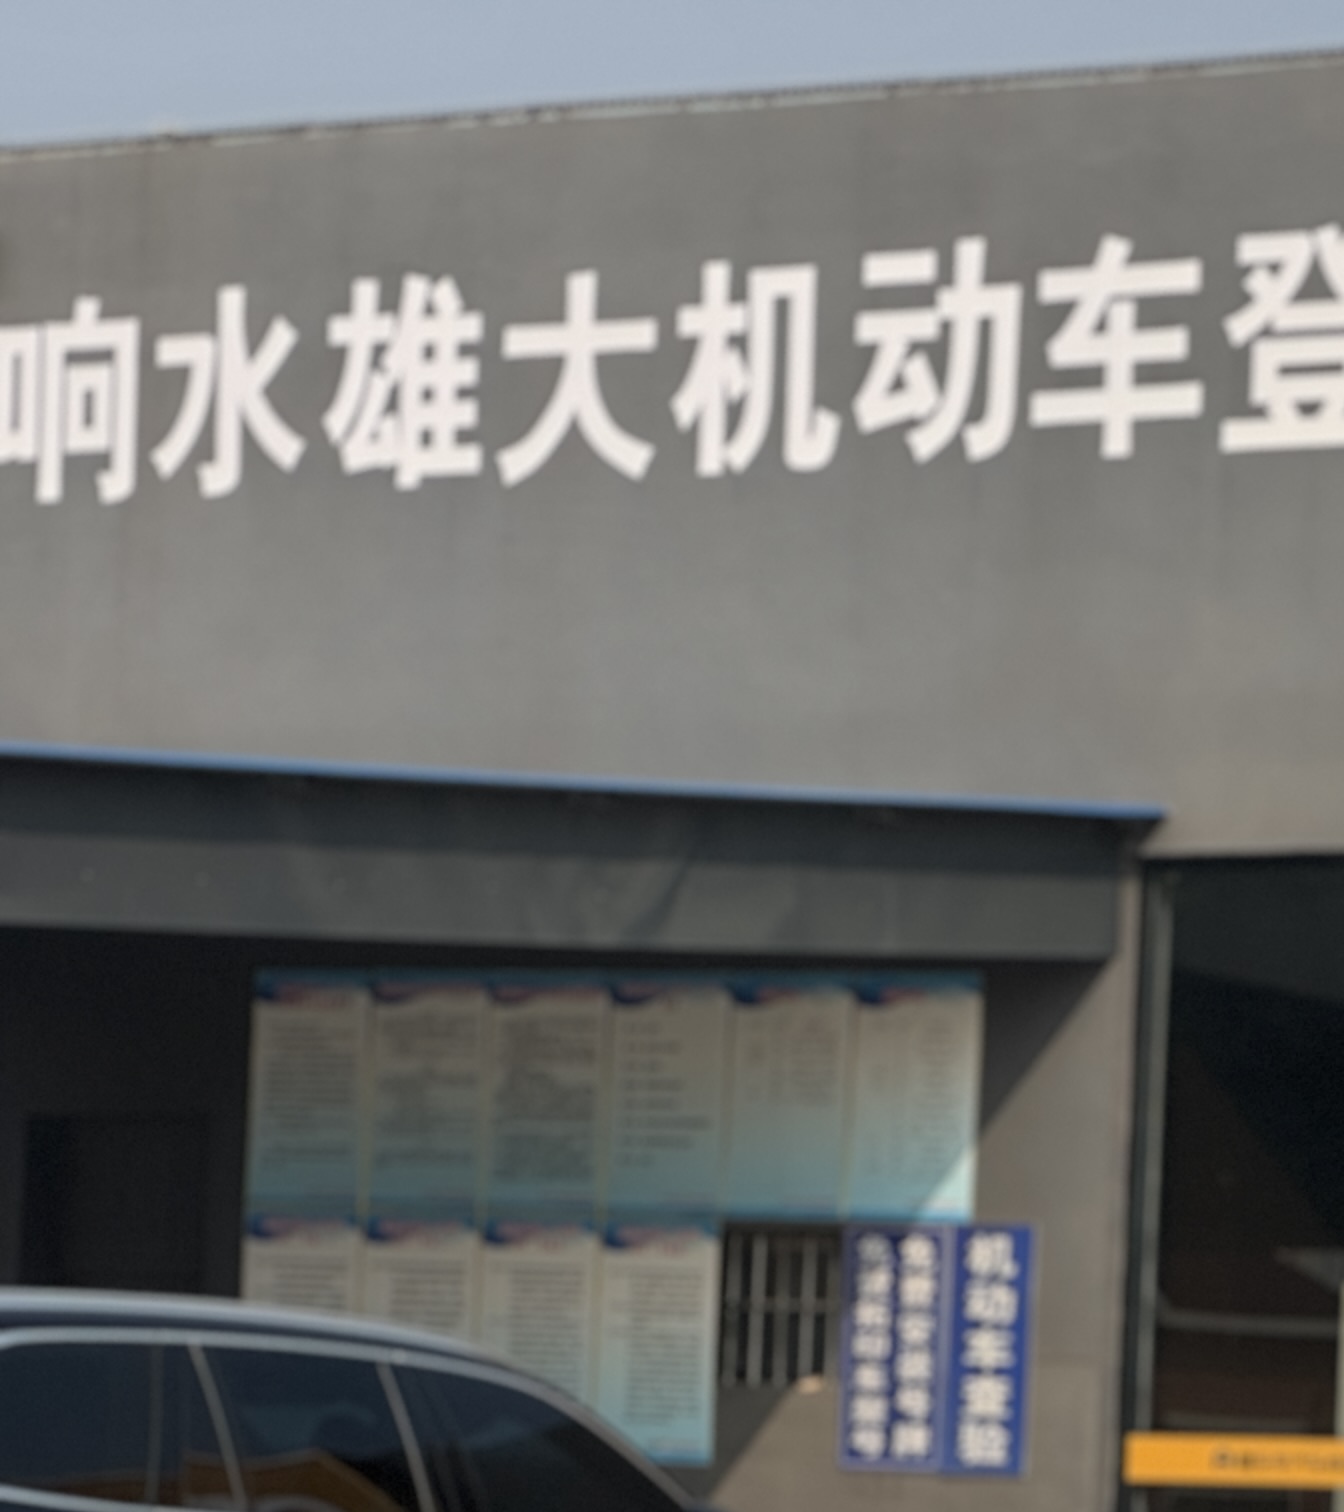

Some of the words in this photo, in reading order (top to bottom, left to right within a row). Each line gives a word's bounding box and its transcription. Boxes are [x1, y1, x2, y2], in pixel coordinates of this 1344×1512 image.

[957, 1231, 1020, 1467] 机动车查验
